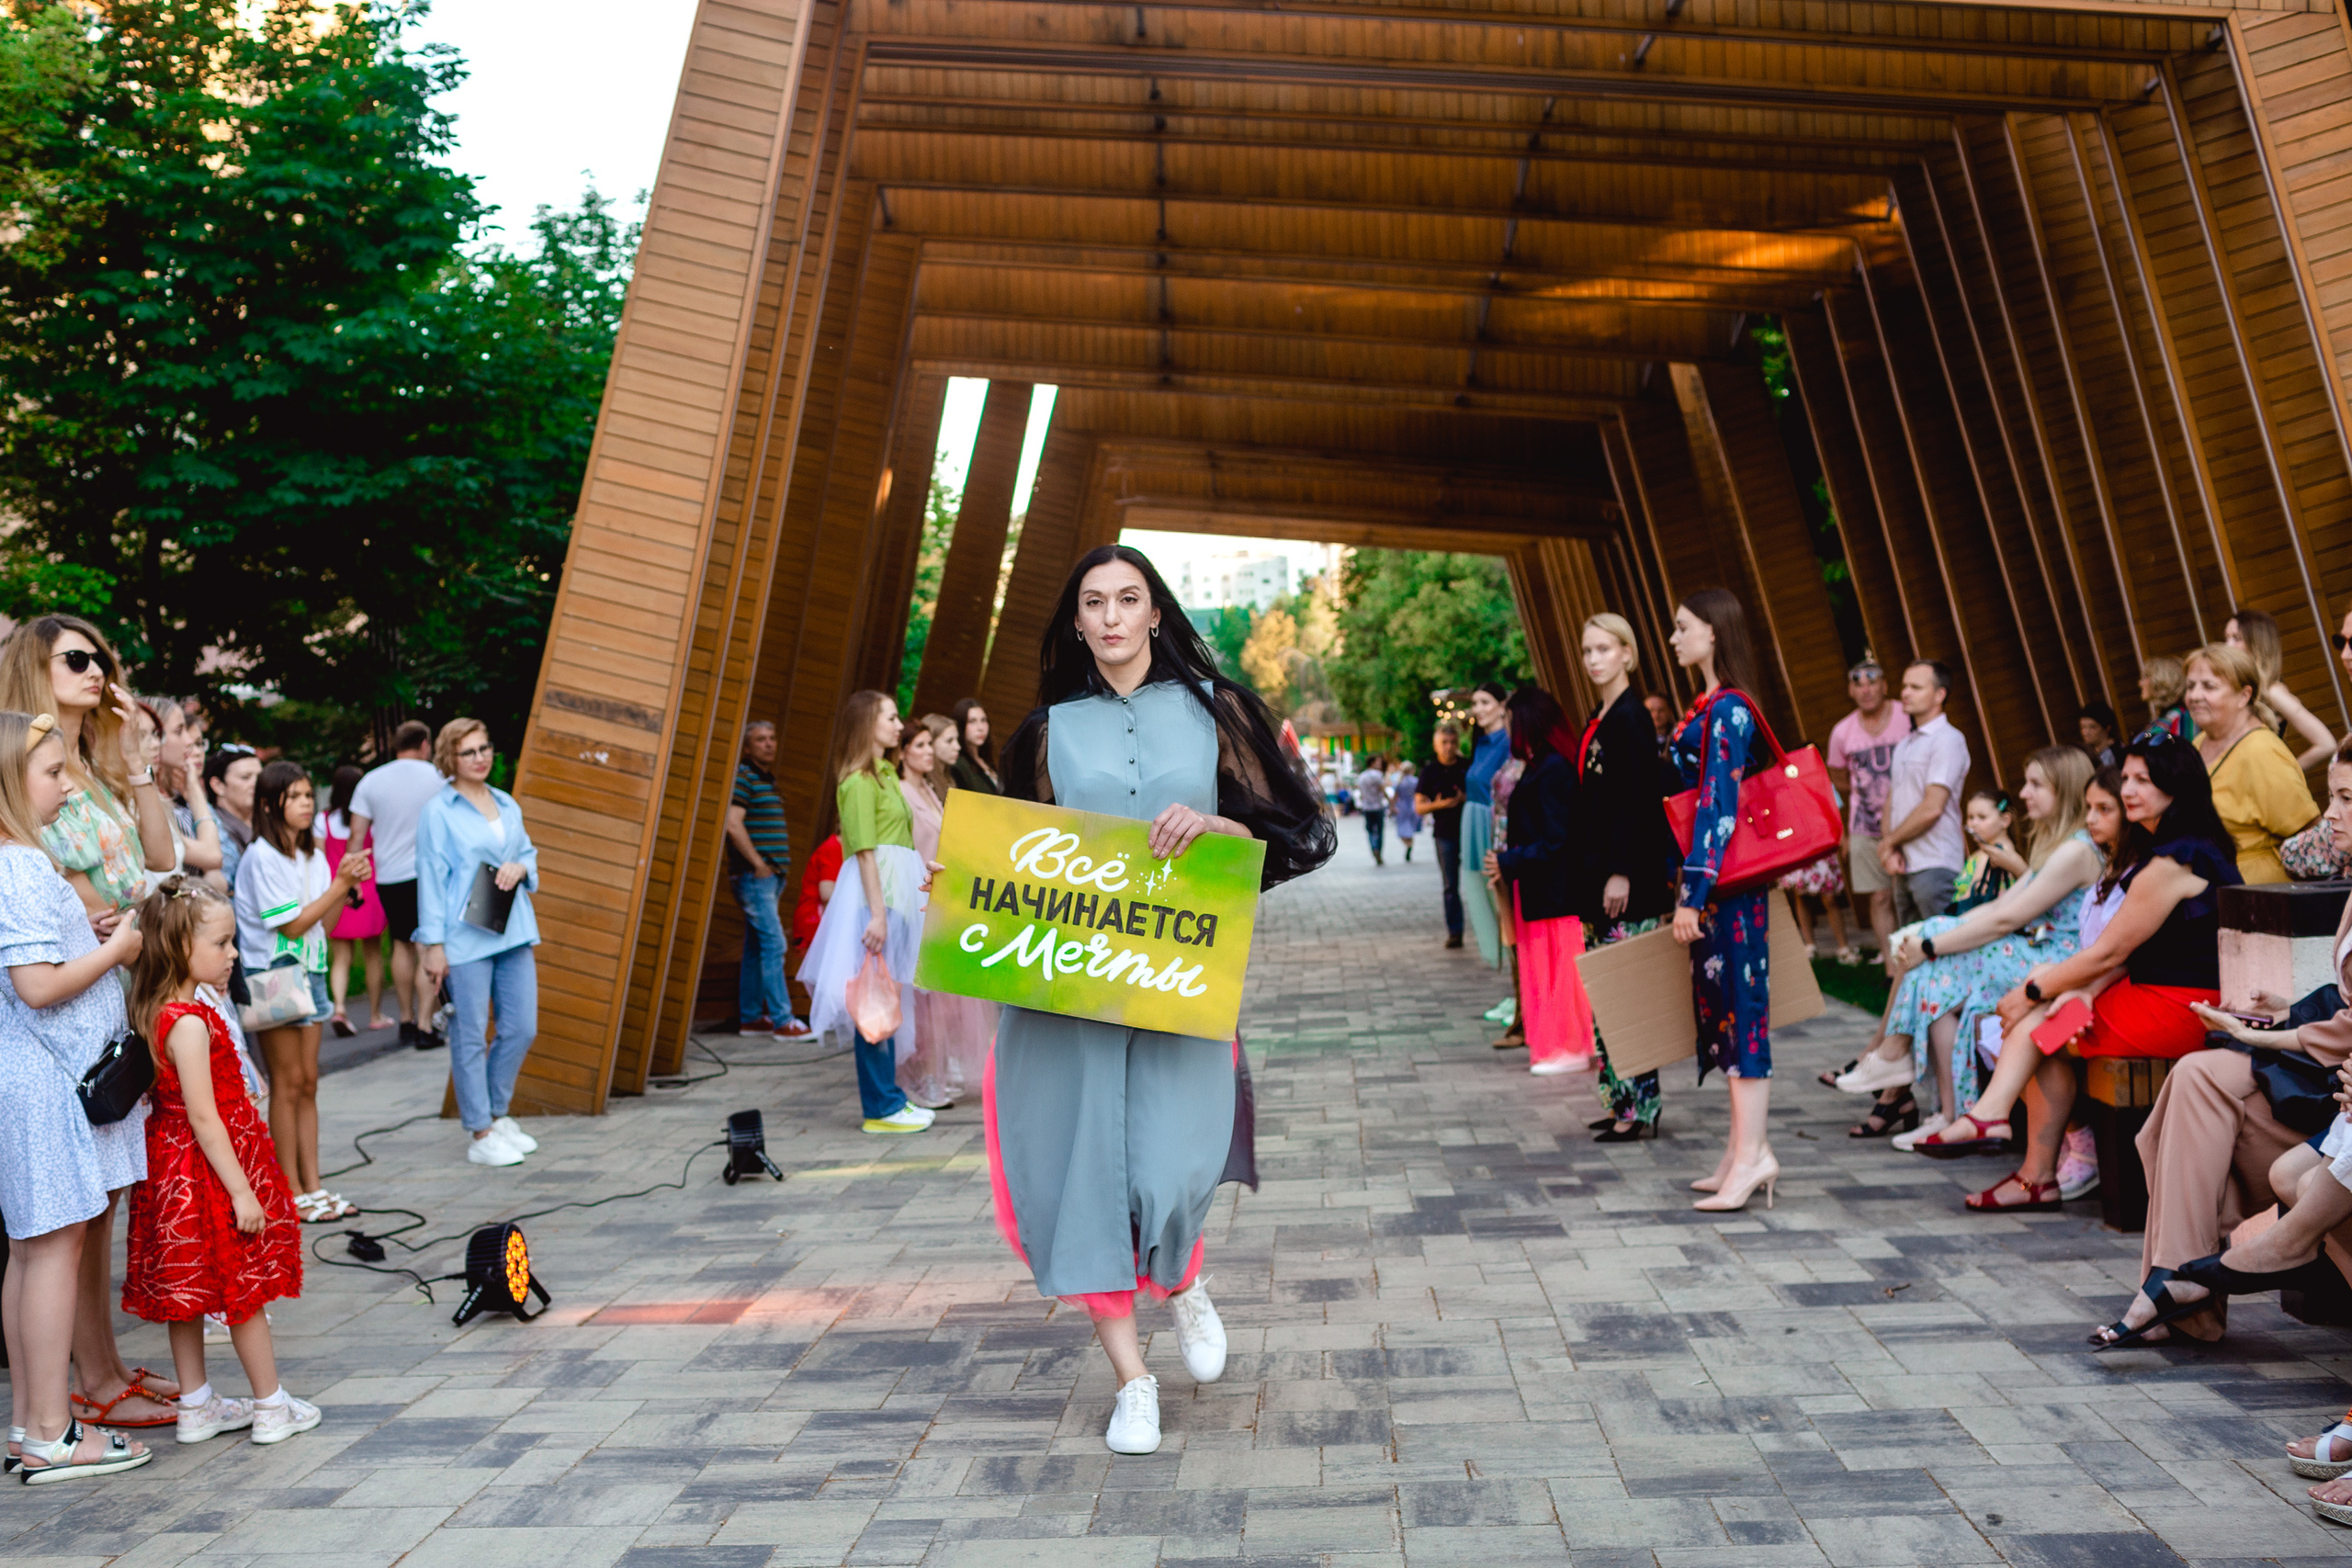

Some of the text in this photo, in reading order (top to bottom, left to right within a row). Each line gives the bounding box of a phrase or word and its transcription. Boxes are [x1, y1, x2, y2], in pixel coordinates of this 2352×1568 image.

[1009, 827, 1131, 893] Всё
[969, 876, 1219, 948] НАЧИНАЕТСЯ
[959, 922, 1208, 998] с Мечты
